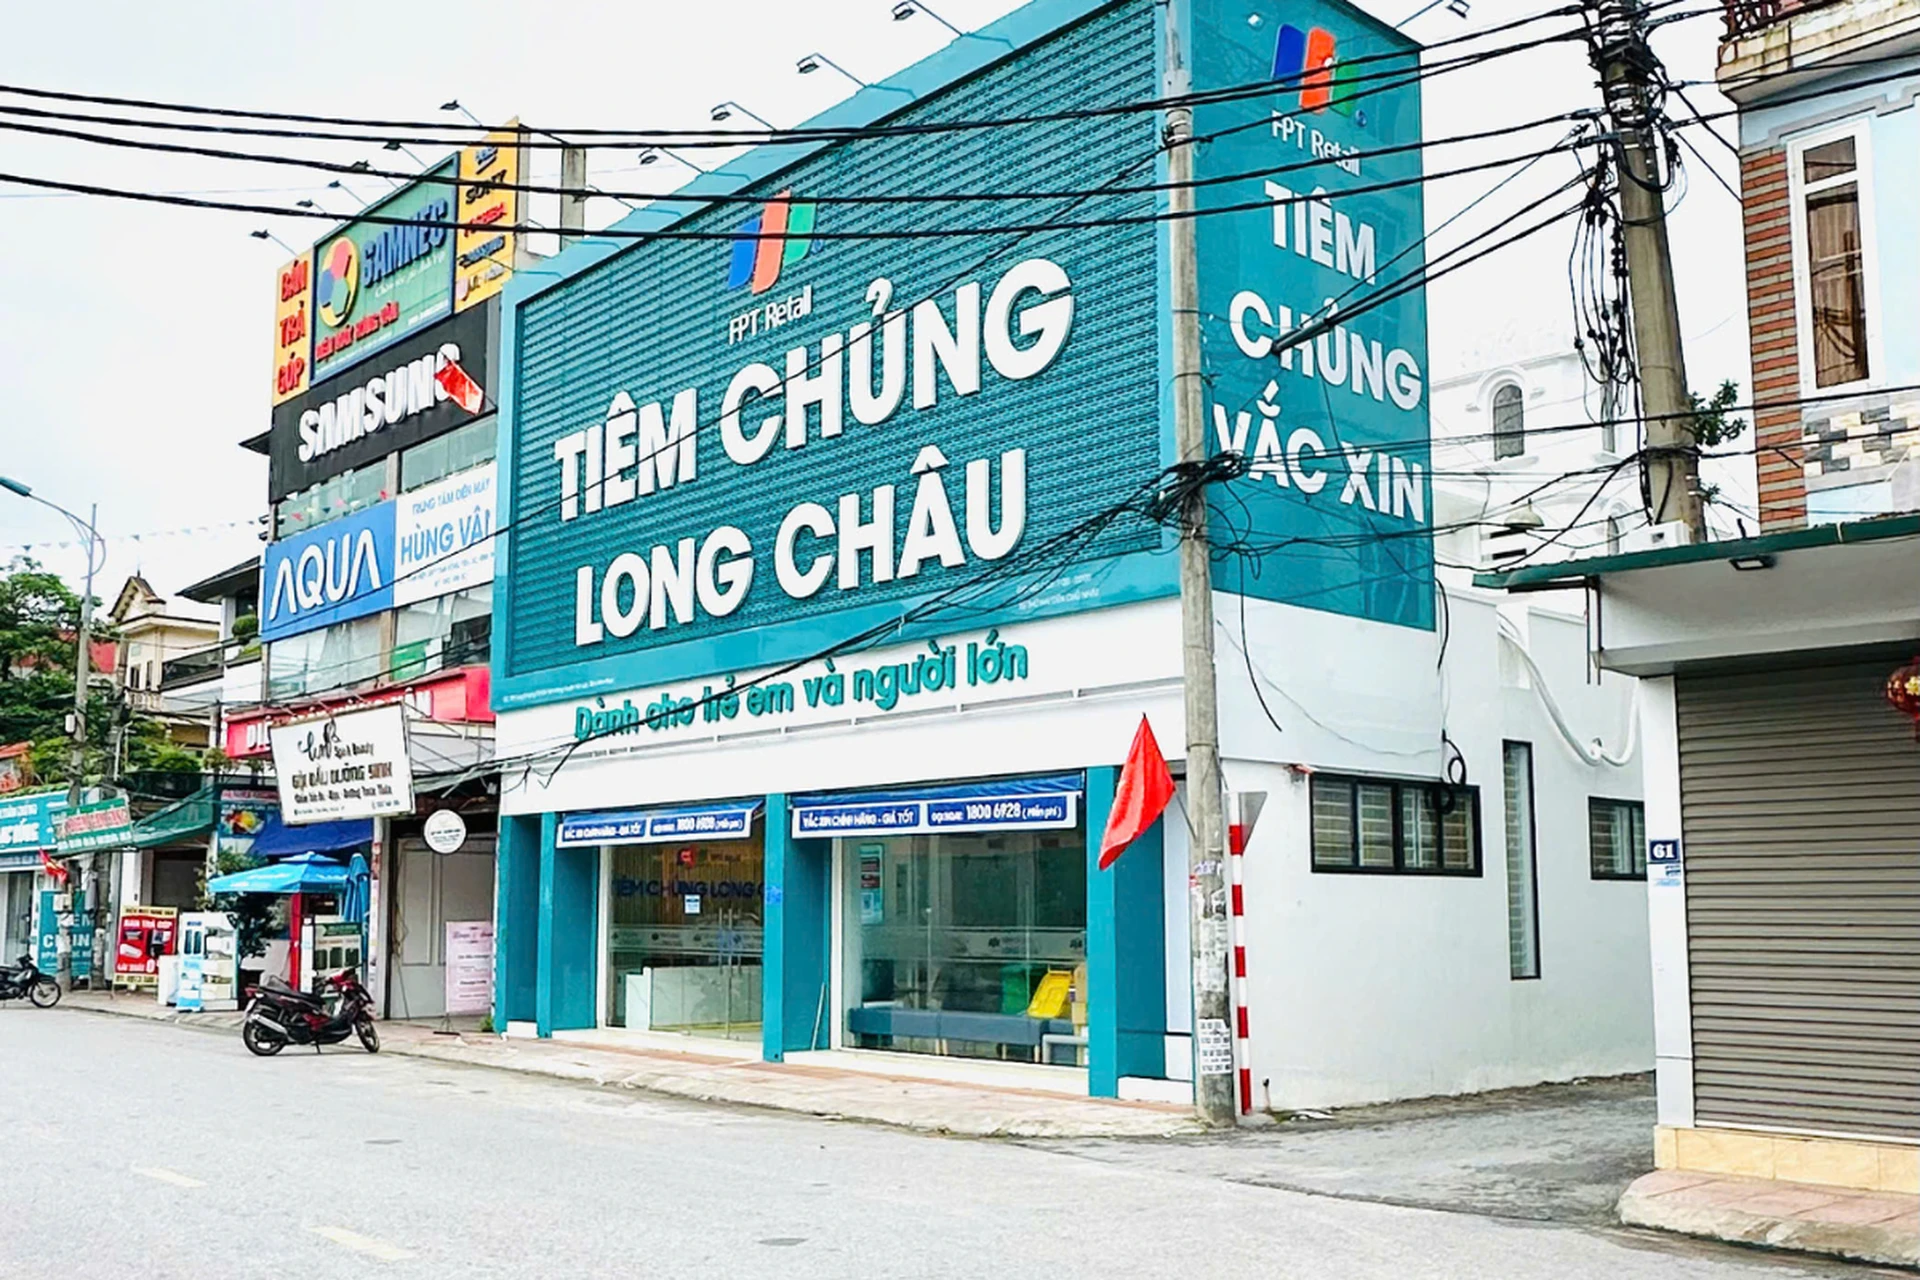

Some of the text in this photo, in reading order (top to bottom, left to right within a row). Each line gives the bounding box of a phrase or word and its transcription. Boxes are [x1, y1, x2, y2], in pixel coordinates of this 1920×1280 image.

[1272, 110, 1360, 177] FPT Retail
[1264, 180, 1377, 286] TIÊM
[730, 285, 812, 345] FPT Retail
[1229, 290, 1423, 412] CHỦNG
[555, 258, 1075, 522] TIÊM CHỦNG
[1213, 379, 1425, 524] VẮC XIN
[401, 522, 455, 565] HÙNG
[575, 444, 1027, 646] LONG CHÂU
[574, 628, 1029, 741] Dành cho trẻ em và người lớn
[966, 804, 991, 820] 1800
[993, 801, 1021, 819] 6928
[1652, 843, 1676, 859] 61
